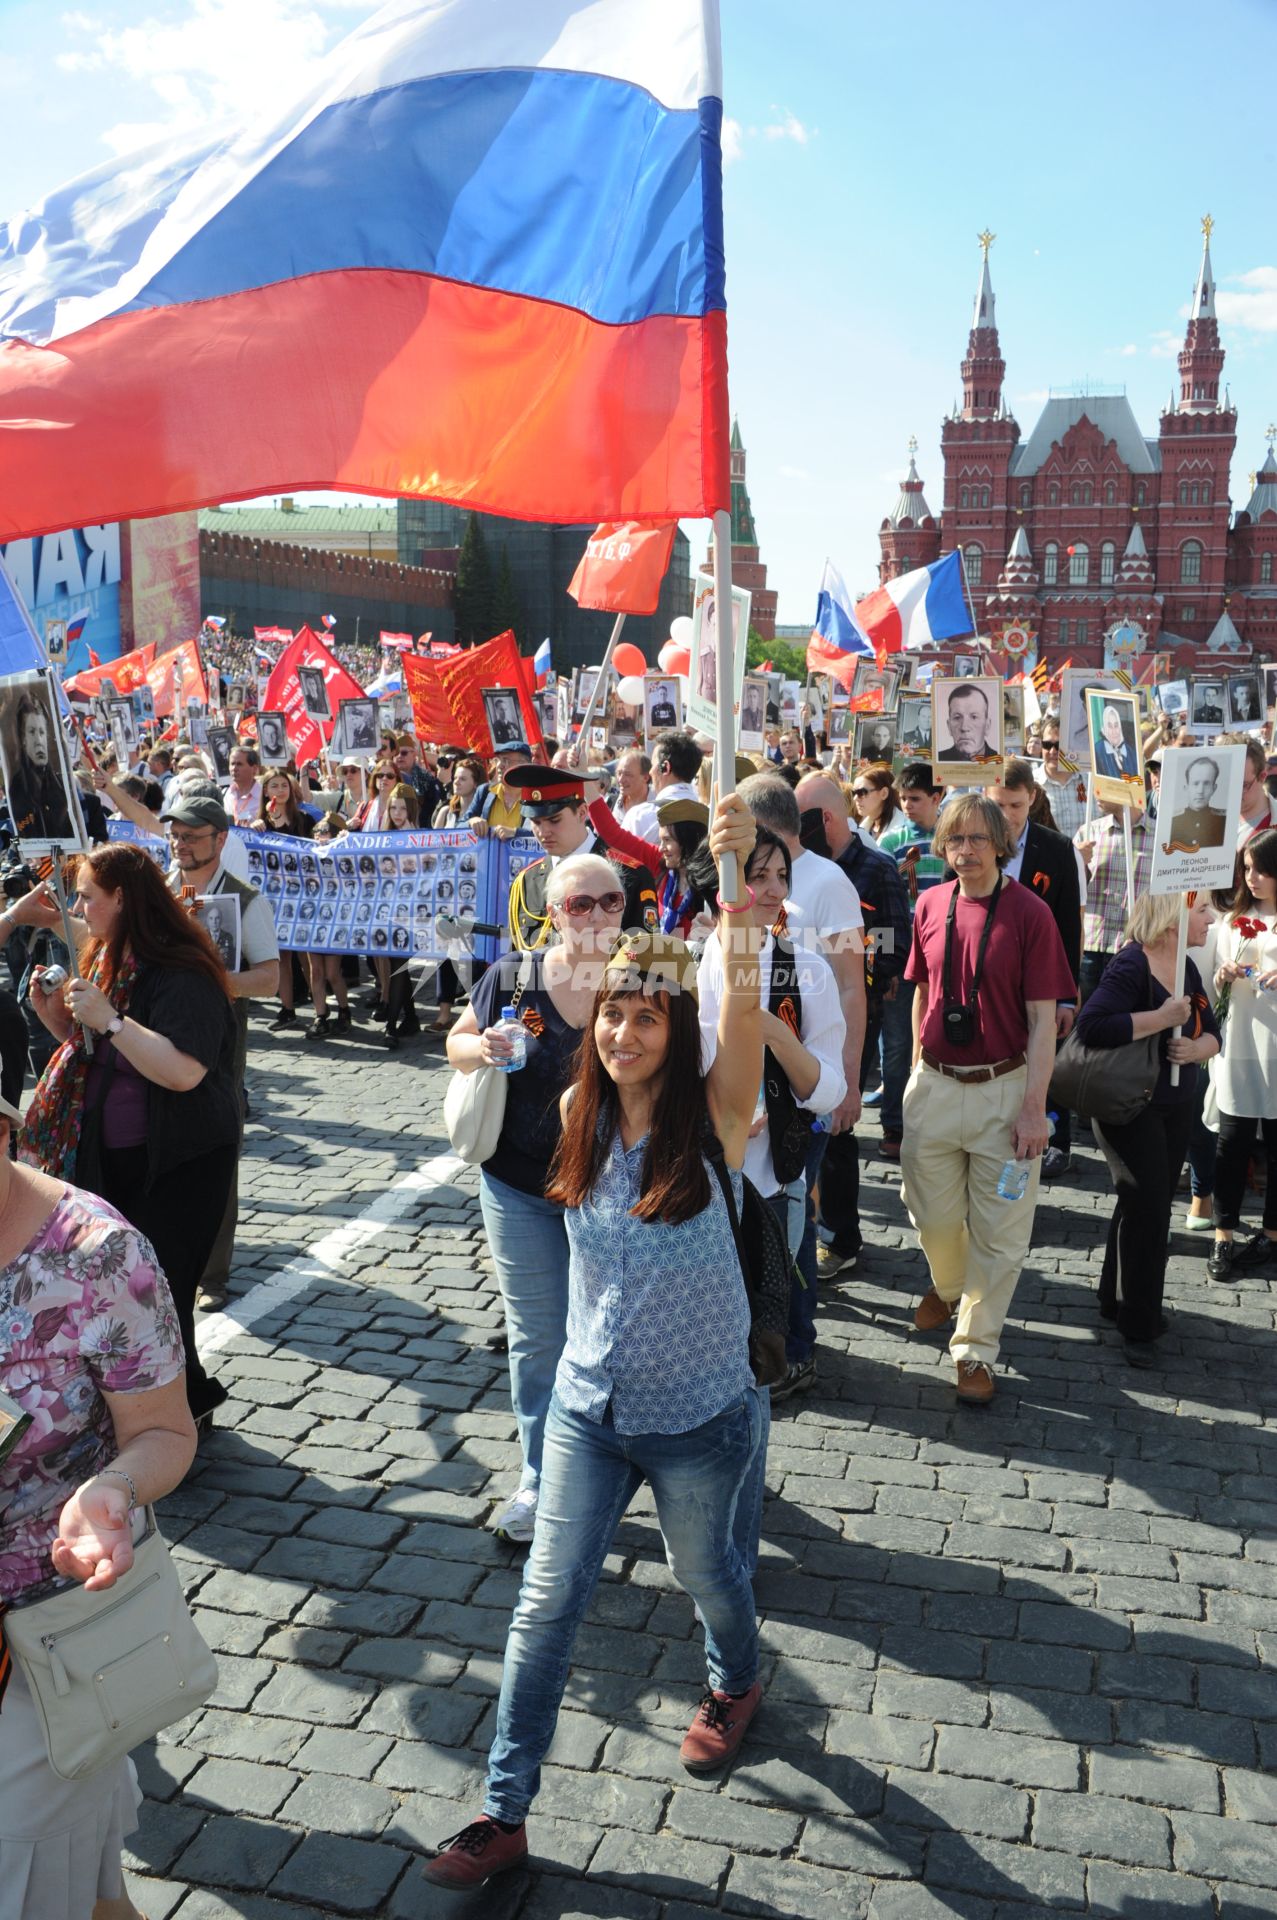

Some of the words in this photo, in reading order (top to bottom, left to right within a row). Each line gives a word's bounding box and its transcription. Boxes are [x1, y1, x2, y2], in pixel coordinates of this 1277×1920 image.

[406, 833, 478, 848] NIEMEN
[1181, 857, 1209, 866] ЛЕОНОВ
[1157, 868, 1189, 877] ДМИТРИЙ
[1191, 864, 1230, 873] АНДРЕЕВИЧ
